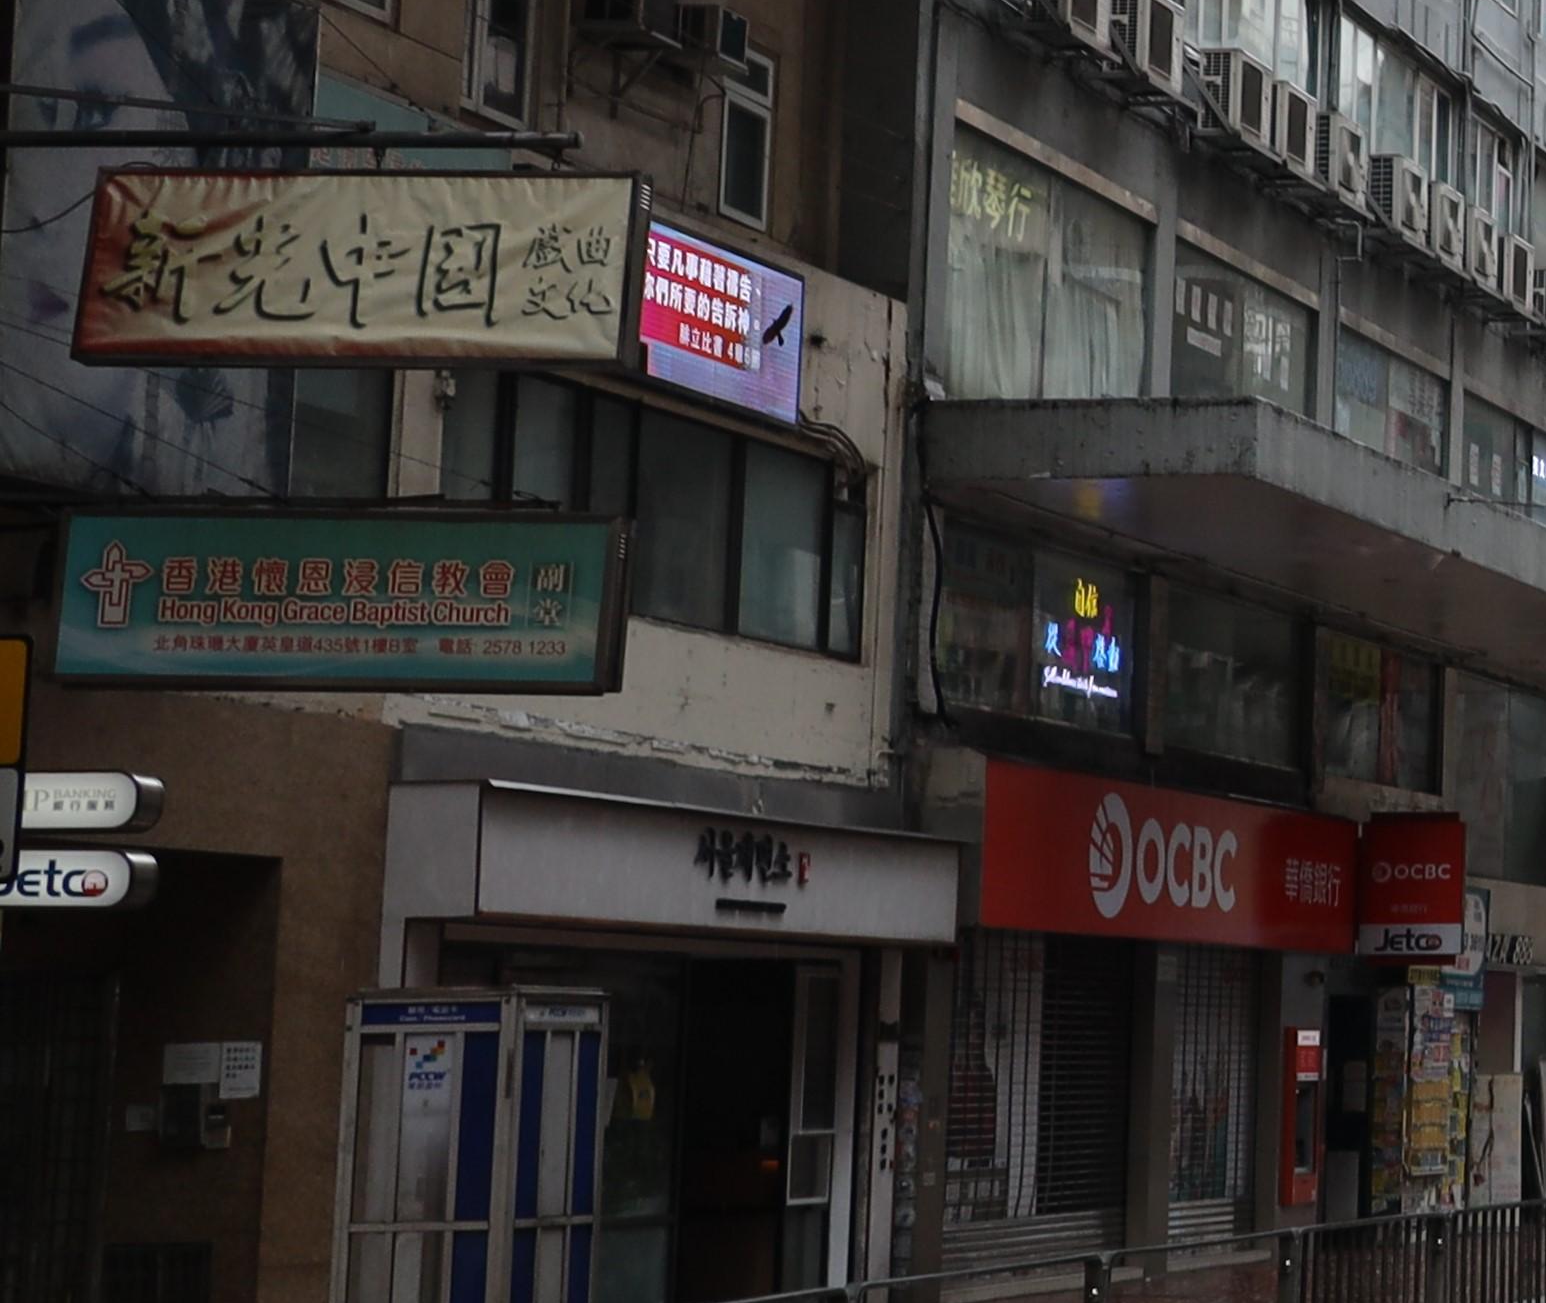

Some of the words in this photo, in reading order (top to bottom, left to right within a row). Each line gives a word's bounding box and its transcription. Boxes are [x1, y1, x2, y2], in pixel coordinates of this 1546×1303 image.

[99, 210, 503, 330] 新光中國
[161, 557, 516, 598] 香港懷恩浸信教會
[159, 598, 216, 628] Hong
[221, 598, 278, 628] Kong
[283, 599, 346, 623] Grace
[351, 599, 428, 628] Baptist
[432, 601, 511, 625] Church
[482, 638, 522, 655] 2578
[528, 638, 567, 655] 1233
[52, 788, 117, 800] BANKING
[1136, 816, 1238, 912] OCBC
[1394, 863, 1452, 880] OCBC
[1284, 858, 1342, 907] 華僑銀行
[408, 1071, 448, 1082] PCCW
